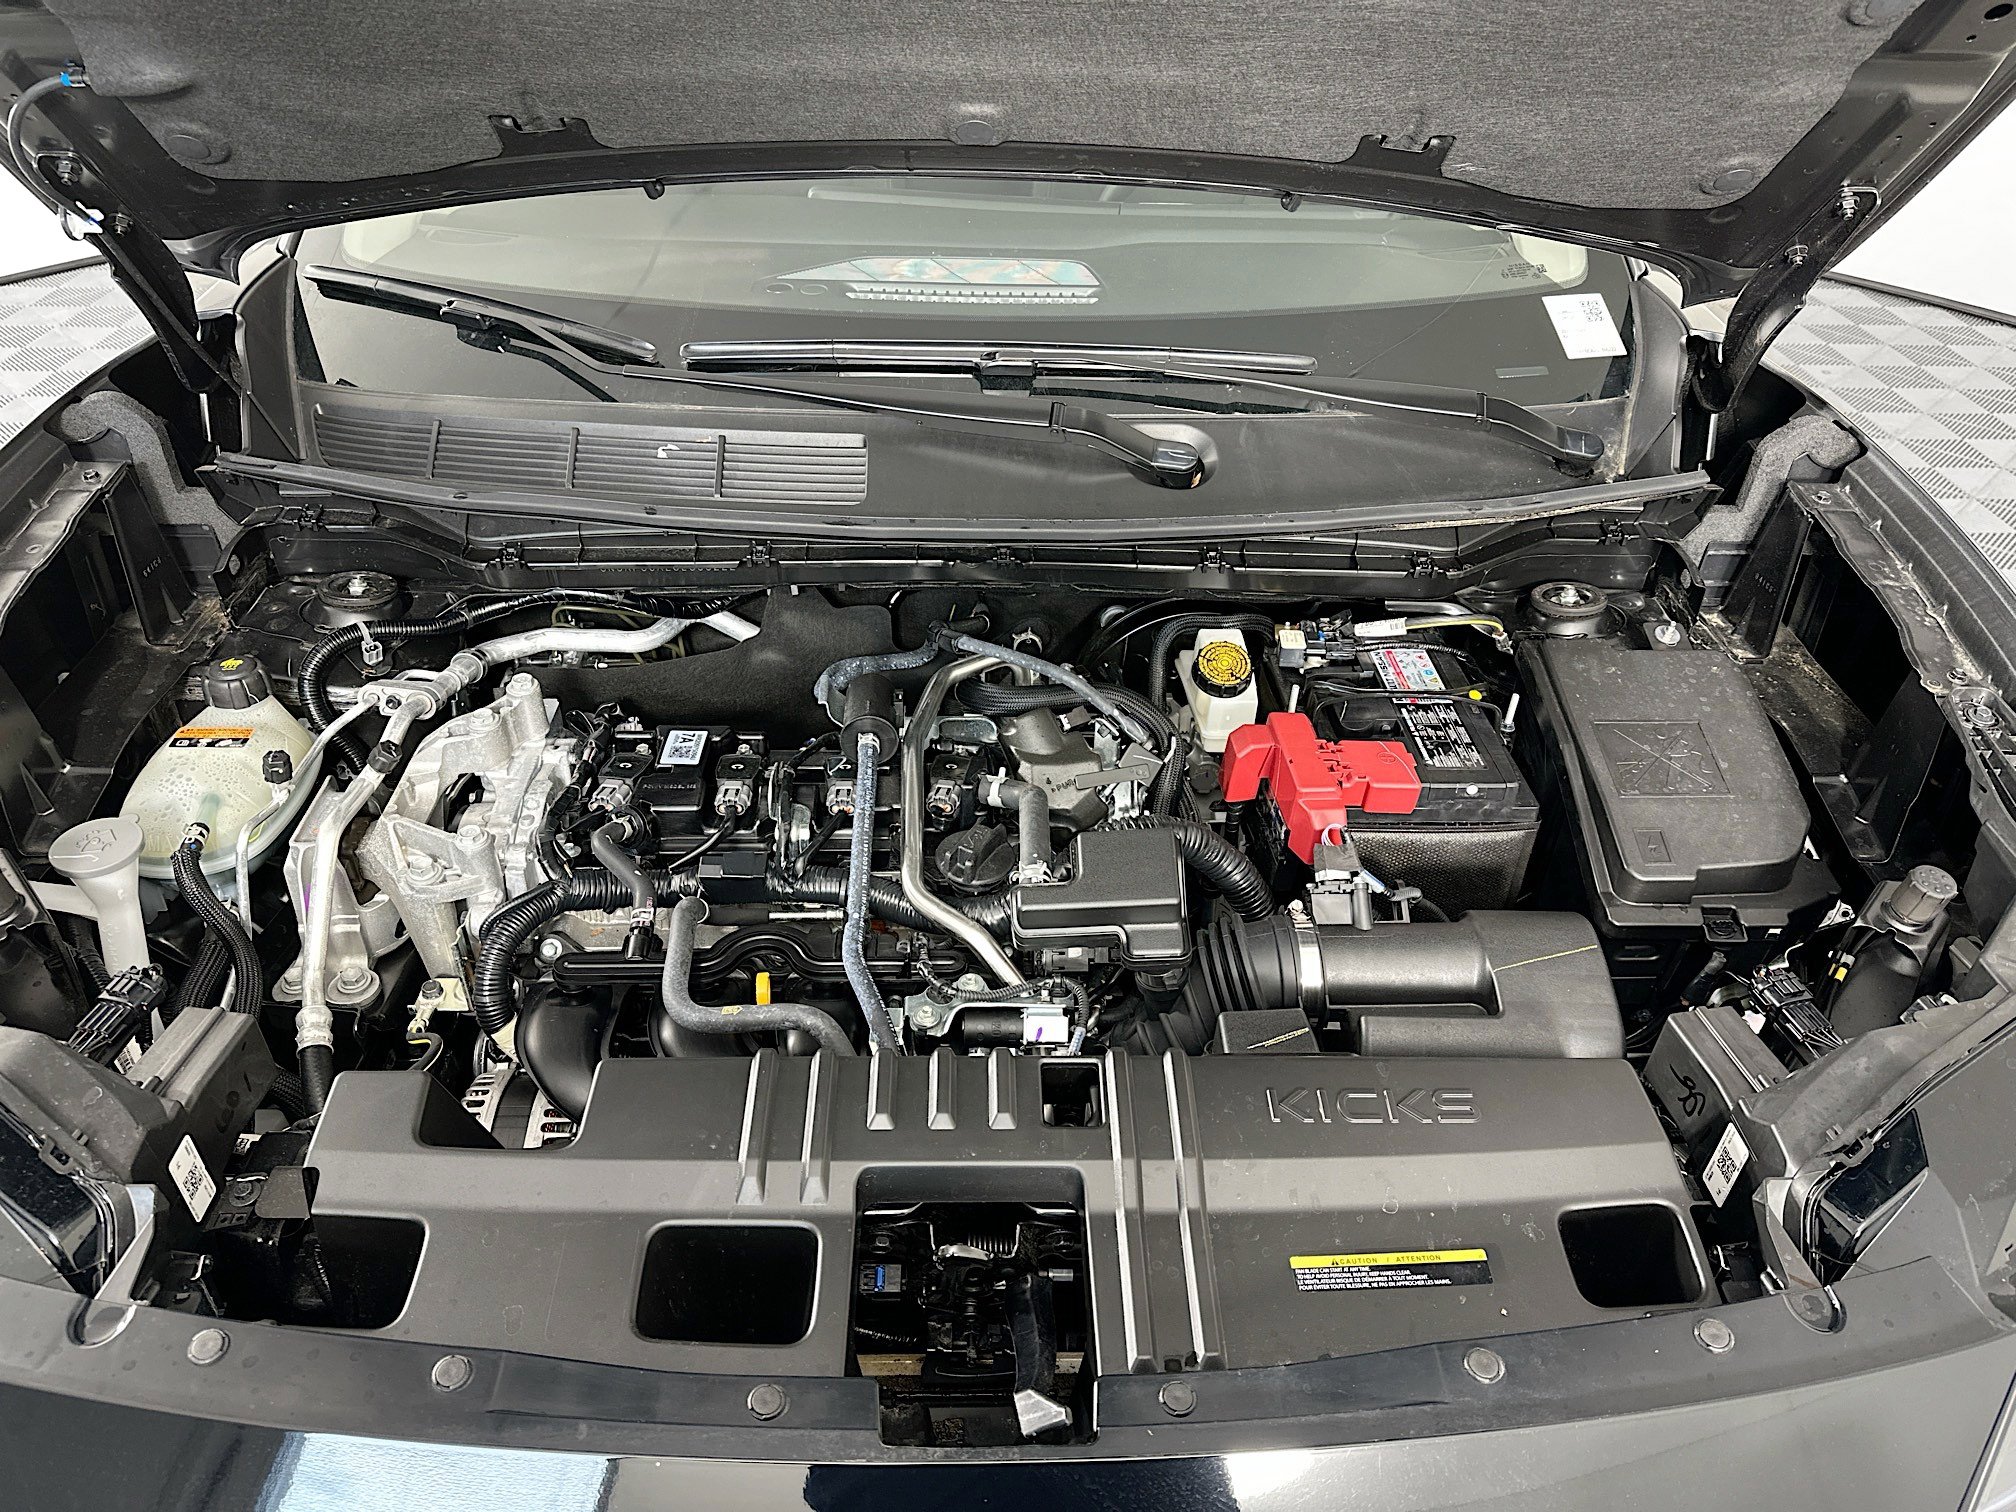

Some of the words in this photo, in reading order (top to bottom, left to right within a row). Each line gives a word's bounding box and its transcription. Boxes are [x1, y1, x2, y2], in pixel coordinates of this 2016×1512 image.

[1265, 1088, 1483, 1124] KICKS
[1339, 1257, 1378, 1265] CAUTION
[1396, 1255, 1441, 1263] ATTENTION
